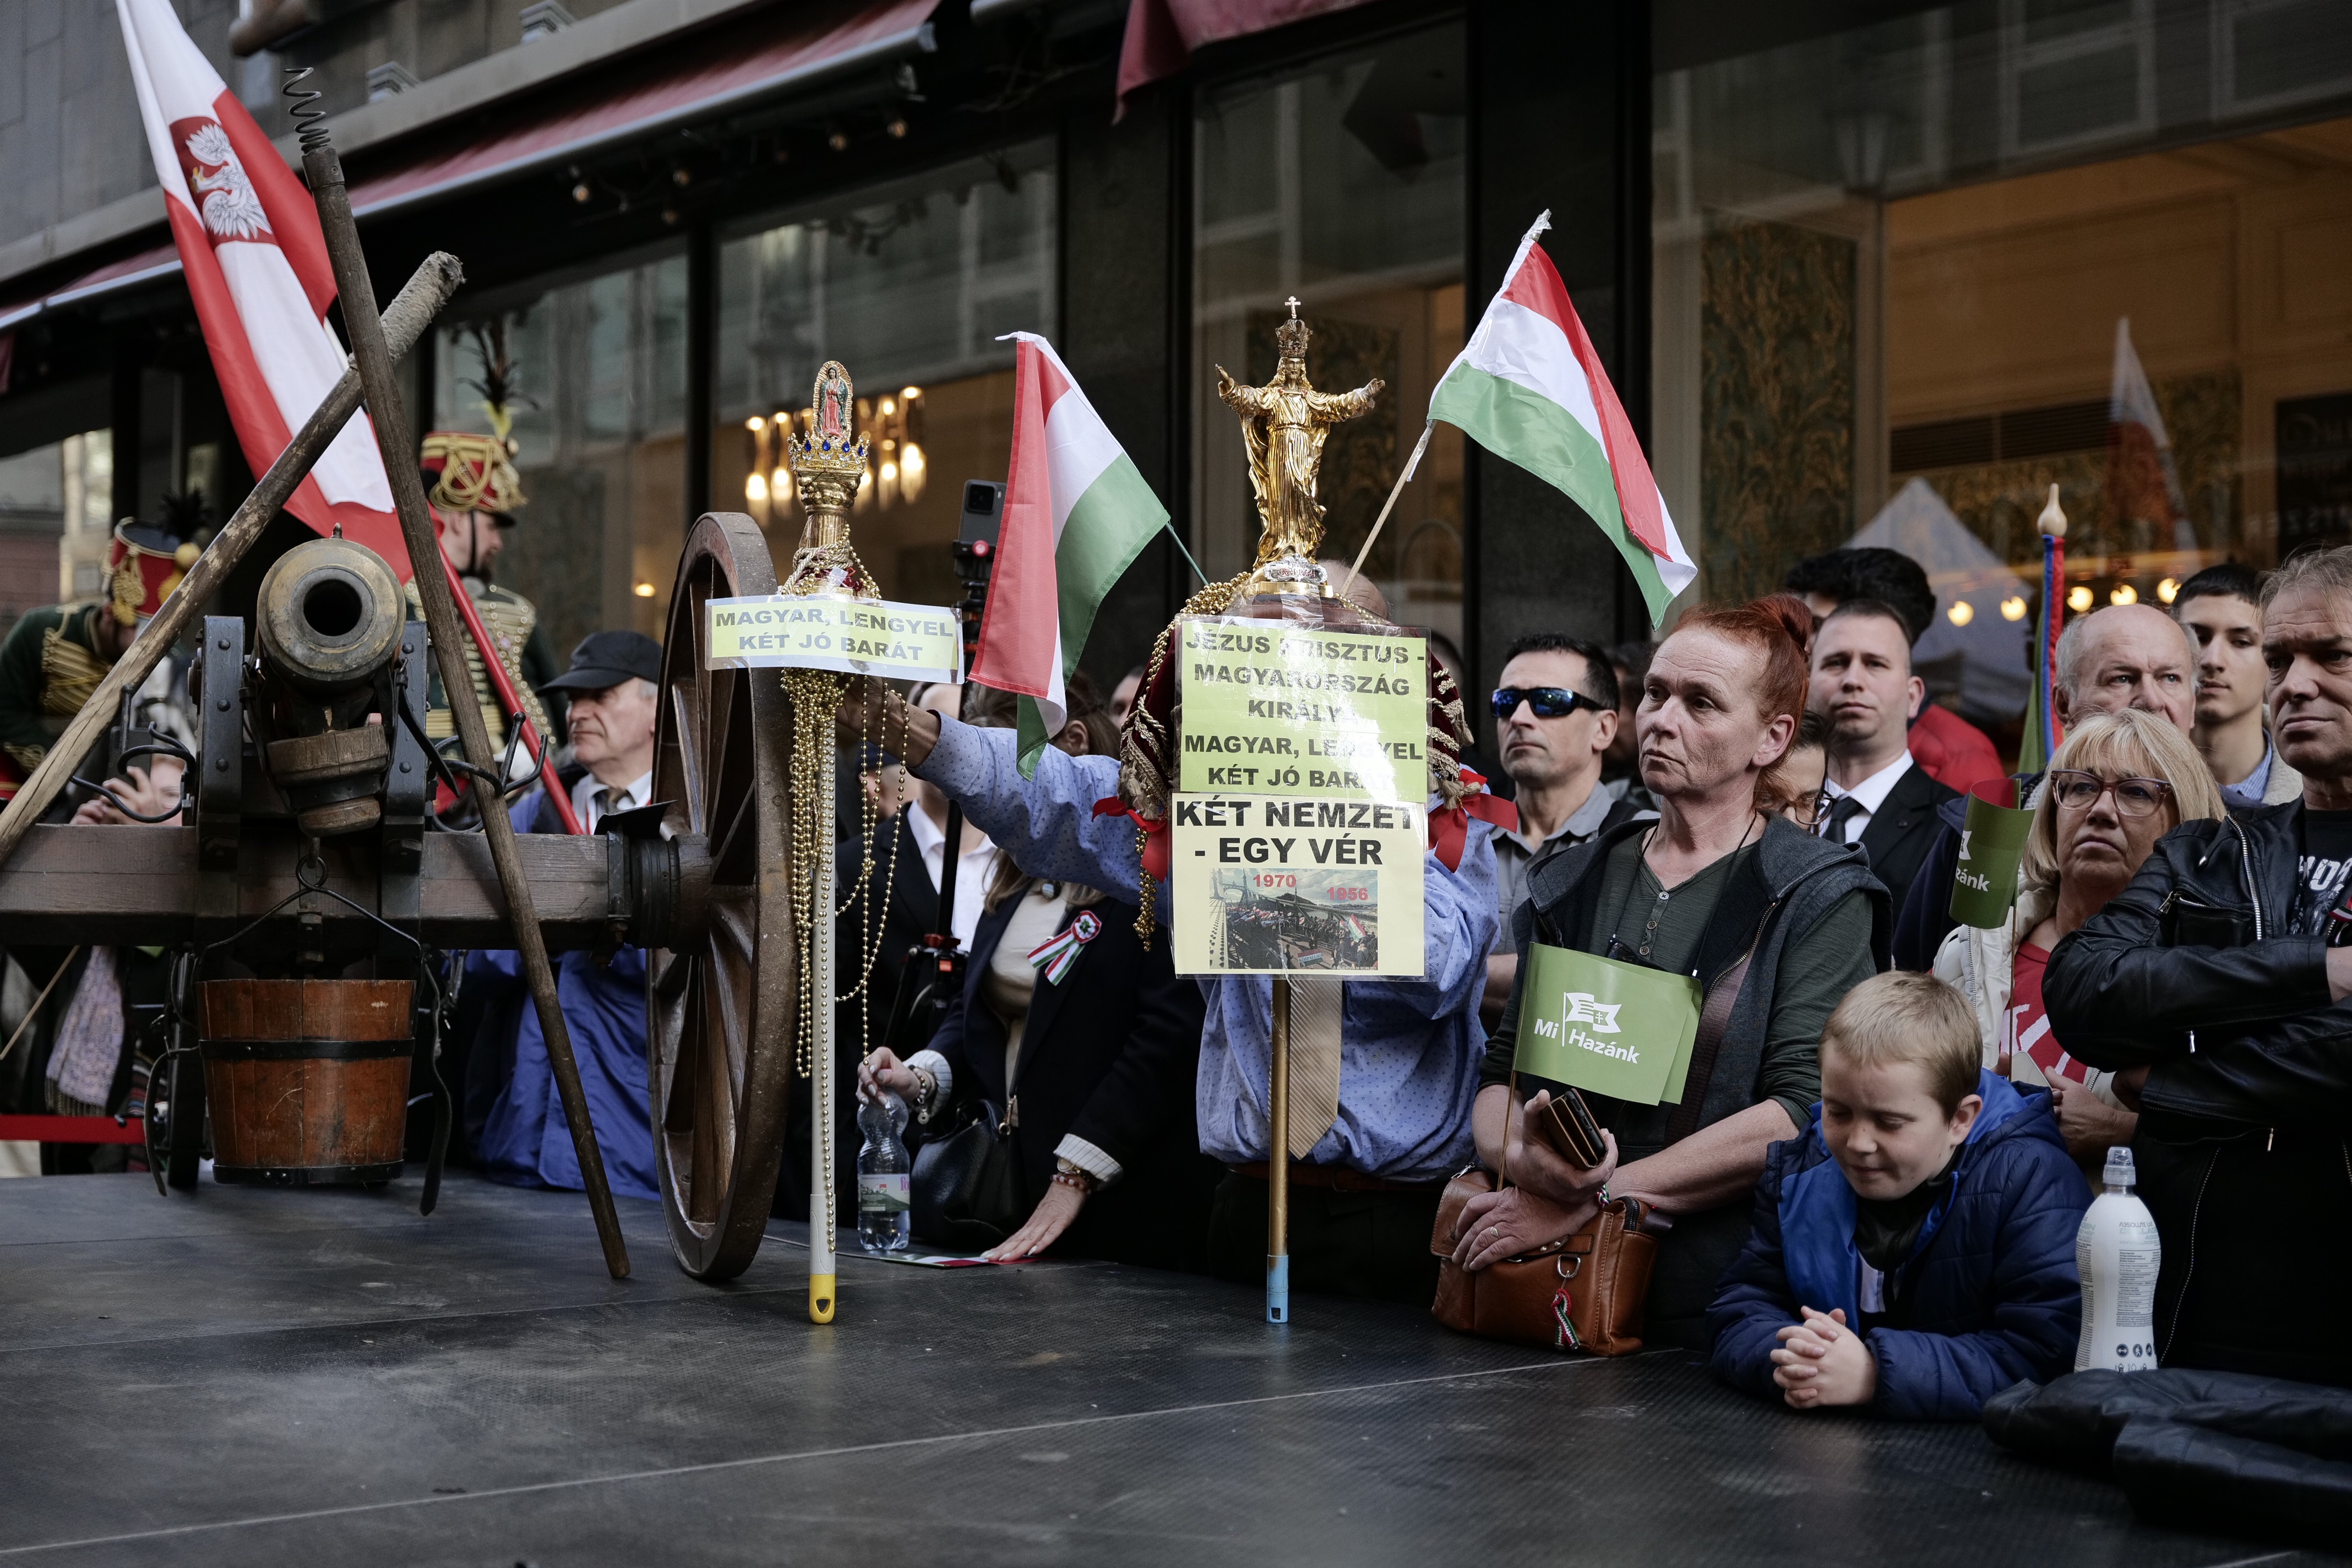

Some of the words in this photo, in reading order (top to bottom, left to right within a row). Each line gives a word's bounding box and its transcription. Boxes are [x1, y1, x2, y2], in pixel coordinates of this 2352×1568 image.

[716, 608, 831, 627] MAGYAR,
[840, 610, 954, 637] LENGYEL
[739, 634, 791, 650] KÉT
[798, 632, 831, 650] JÓ
[841, 637, 923, 661] BARÁT
[1185, 629, 1270, 654] JÉZUS
[1194, 663, 1409, 696] MAGYARORSZÁG
[1185, 735, 1299, 759] MAGYAR,
[1208, 764, 1259, 786] KÉT
[1267, 765, 1300, 787] JÓ
[1177, 794, 1252, 827] KÉT
[1266, 801, 1417, 830] NEMZET
[1219, 836, 1296, 863] EGY
[1308, 832, 1383, 865] VÉR
[1253, 874, 1297, 888] 1970
[1326, 886, 1368, 901] 1956
[1534, 1019, 1559, 1039] Mi
[1569, 1028, 1640, 1064] Hazánk
